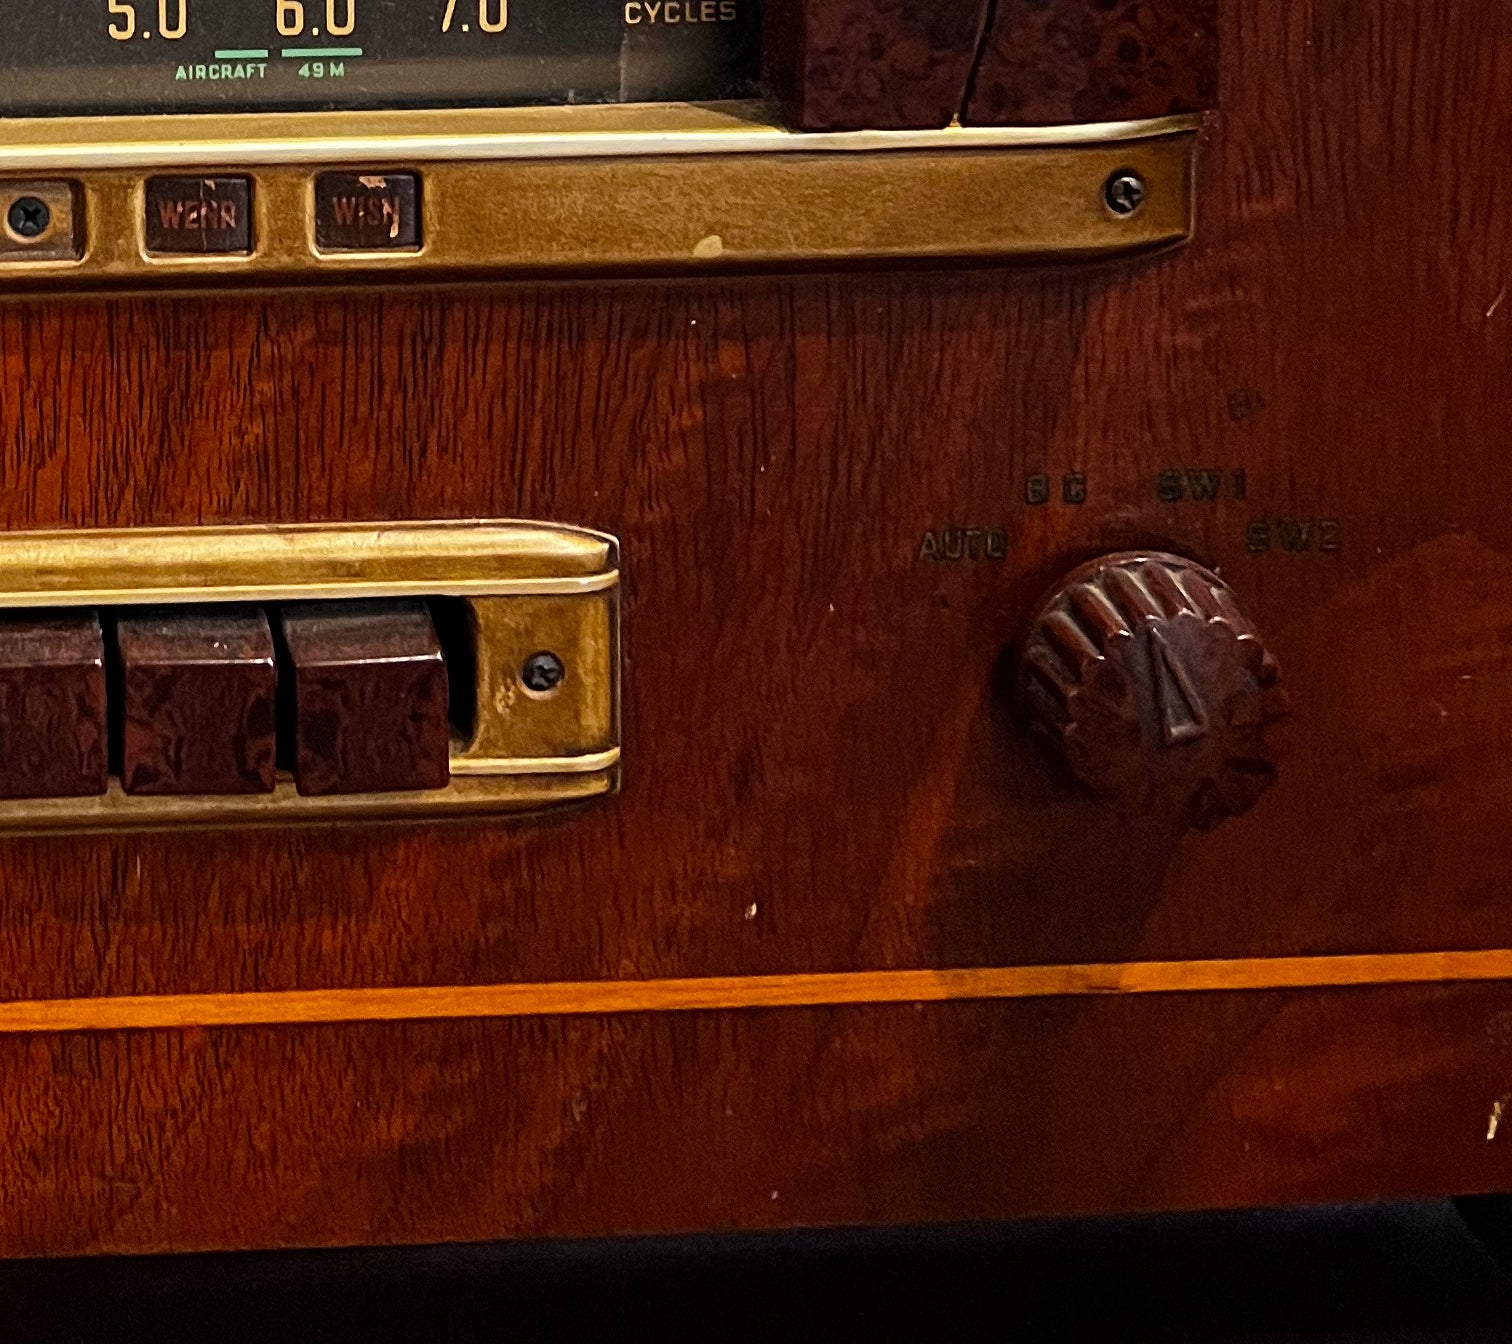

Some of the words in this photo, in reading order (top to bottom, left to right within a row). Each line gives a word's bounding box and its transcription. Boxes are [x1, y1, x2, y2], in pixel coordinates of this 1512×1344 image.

[624, 0, 737, 24] CYCLES
[175, 61, 269, 80] AIRCRAFT
[918, 527, 1008, 561] AUTO
